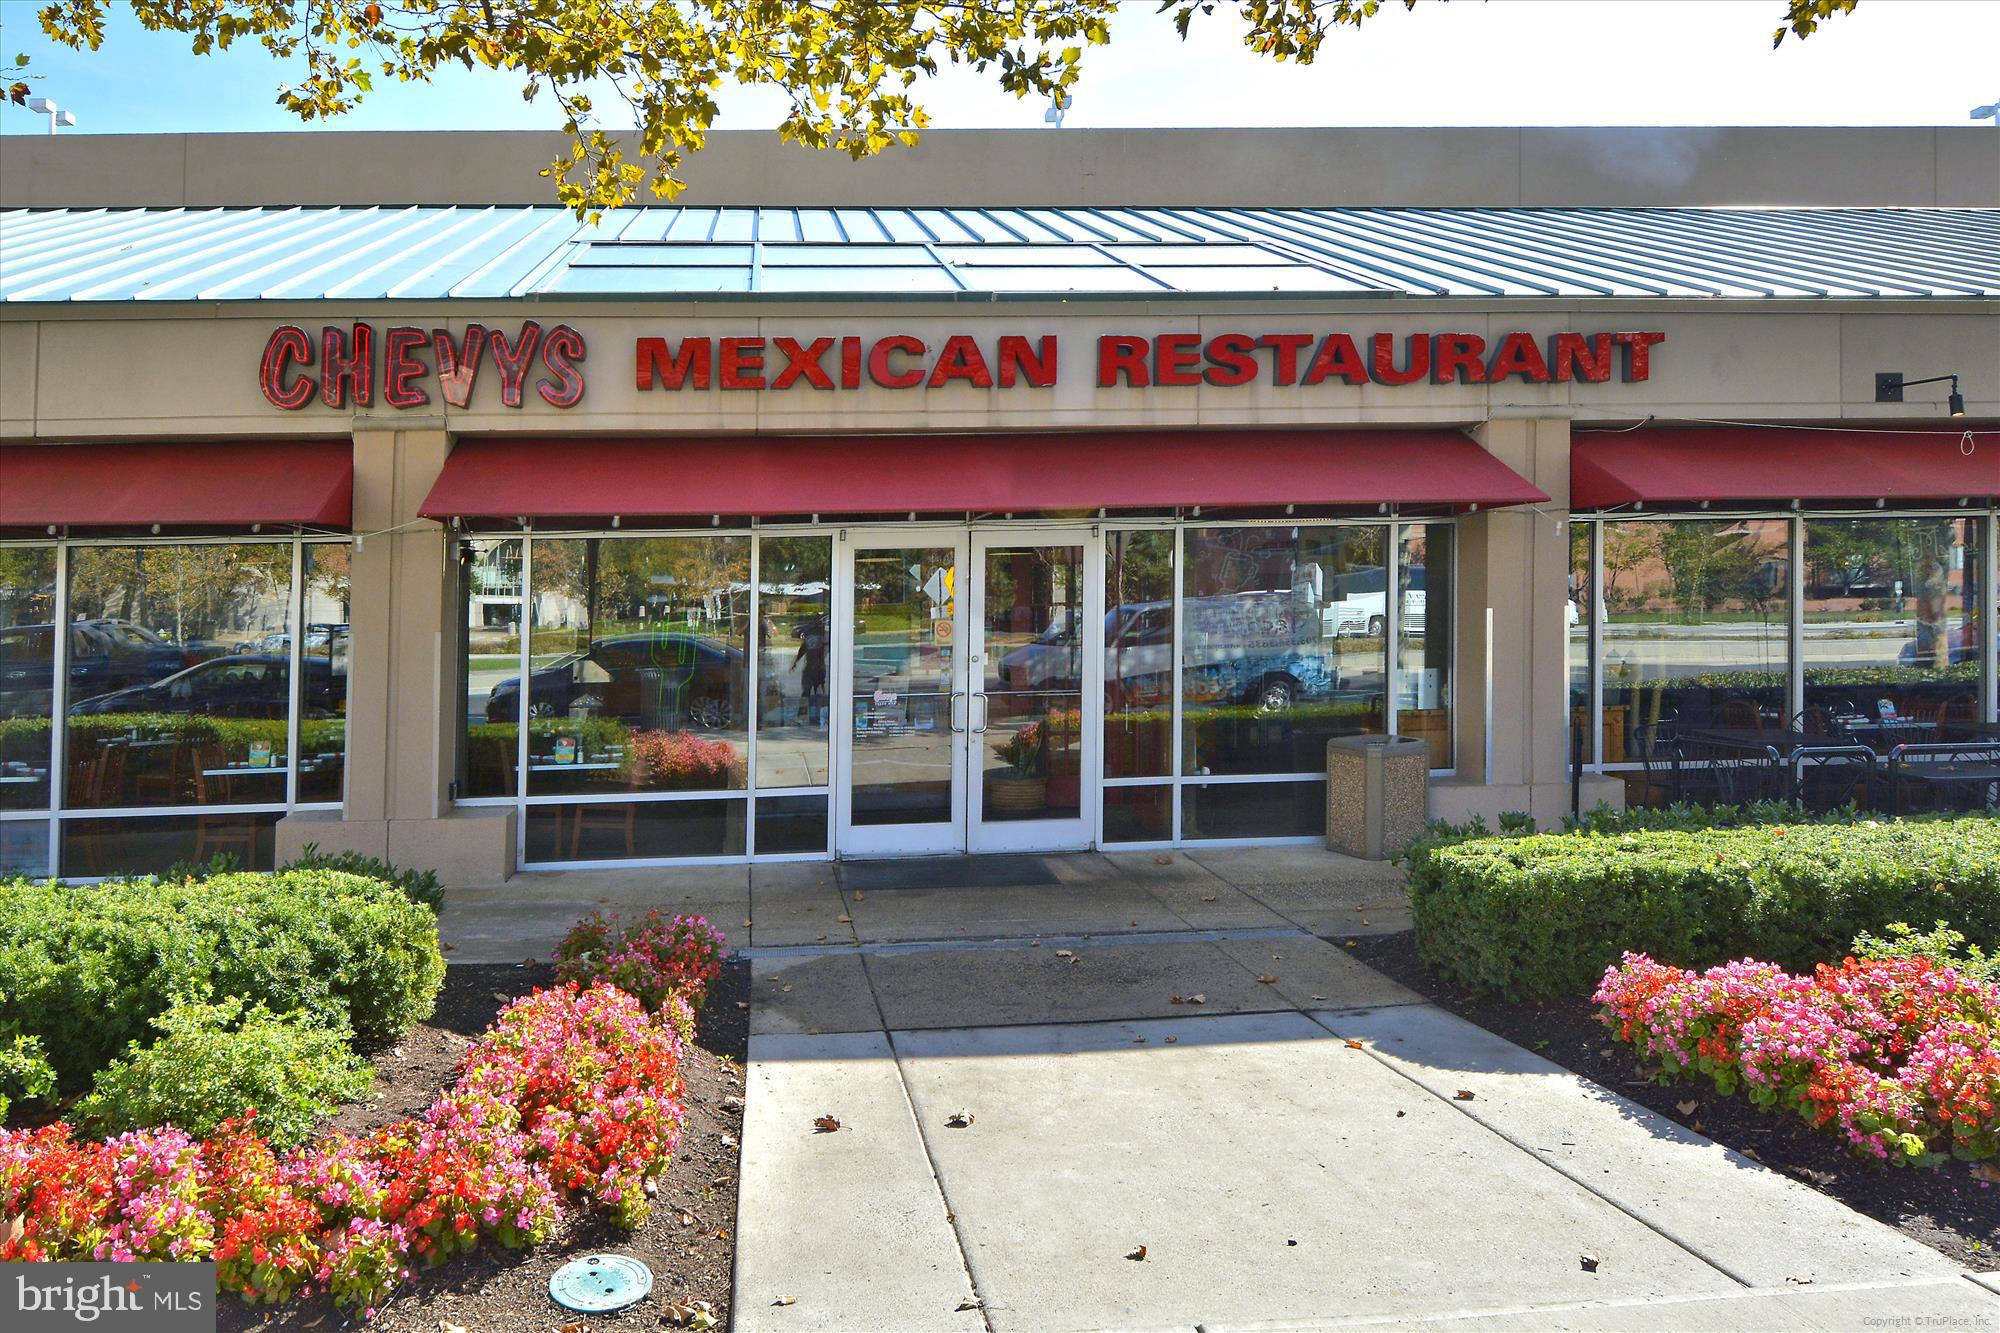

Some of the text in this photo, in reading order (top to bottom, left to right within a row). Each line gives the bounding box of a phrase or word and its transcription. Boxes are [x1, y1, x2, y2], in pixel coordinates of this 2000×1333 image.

[260, 320, 1665, 410] CHEVYS MEXICAN RESTAURANT
